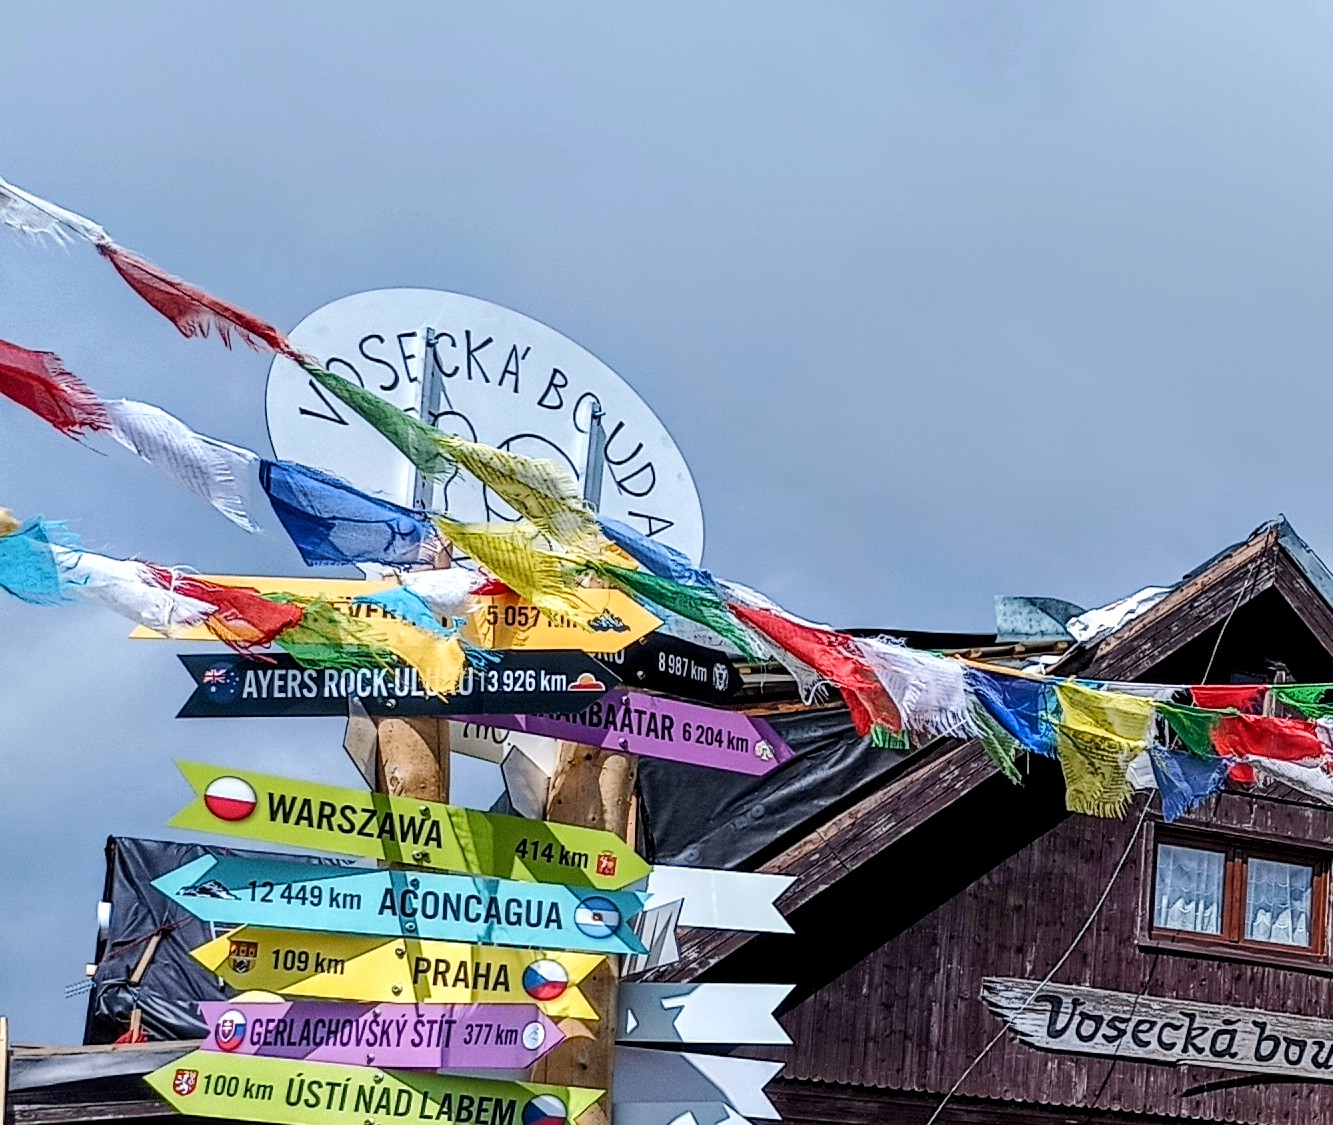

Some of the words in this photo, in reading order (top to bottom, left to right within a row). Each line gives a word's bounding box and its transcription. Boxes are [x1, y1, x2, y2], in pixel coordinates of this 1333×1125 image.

[536, 367, 675, 538] BOUDA
[242, 669, 318, 698] AYERS
[540, 669, 568, 692] km
[690, 658, 707, 682] km
[727, 731, 749, 753] km
[268, 791, 443, 849] WARSZAWA
[514, 837, 554, 863] 414
[559, 843, 589, 869] km
[328, 886, 362, 911] km
[378, 887, 563, 930] ACONCAGUA
[272, 948, 308, 972] 109
[314, 952, 346, 976] km
[412, 956, 511, 992] PRAHA
[249, 1013, 409, 1048] GERLACHOVSKÝ
[410, 1012, 457, 1049] ŠTÍT
[463, 1022, 494, 1046] 377
[494, 1024, 519, 1046] km
[1035, 993, 1240, 1060] Vosecká
[202, 1073, 240, 1098] 100
[243, 1077, 274, 1101] km
[284, 1072, 352, 1112] ÚSTÍ
[353, 1085, 413, 1117] NAD
